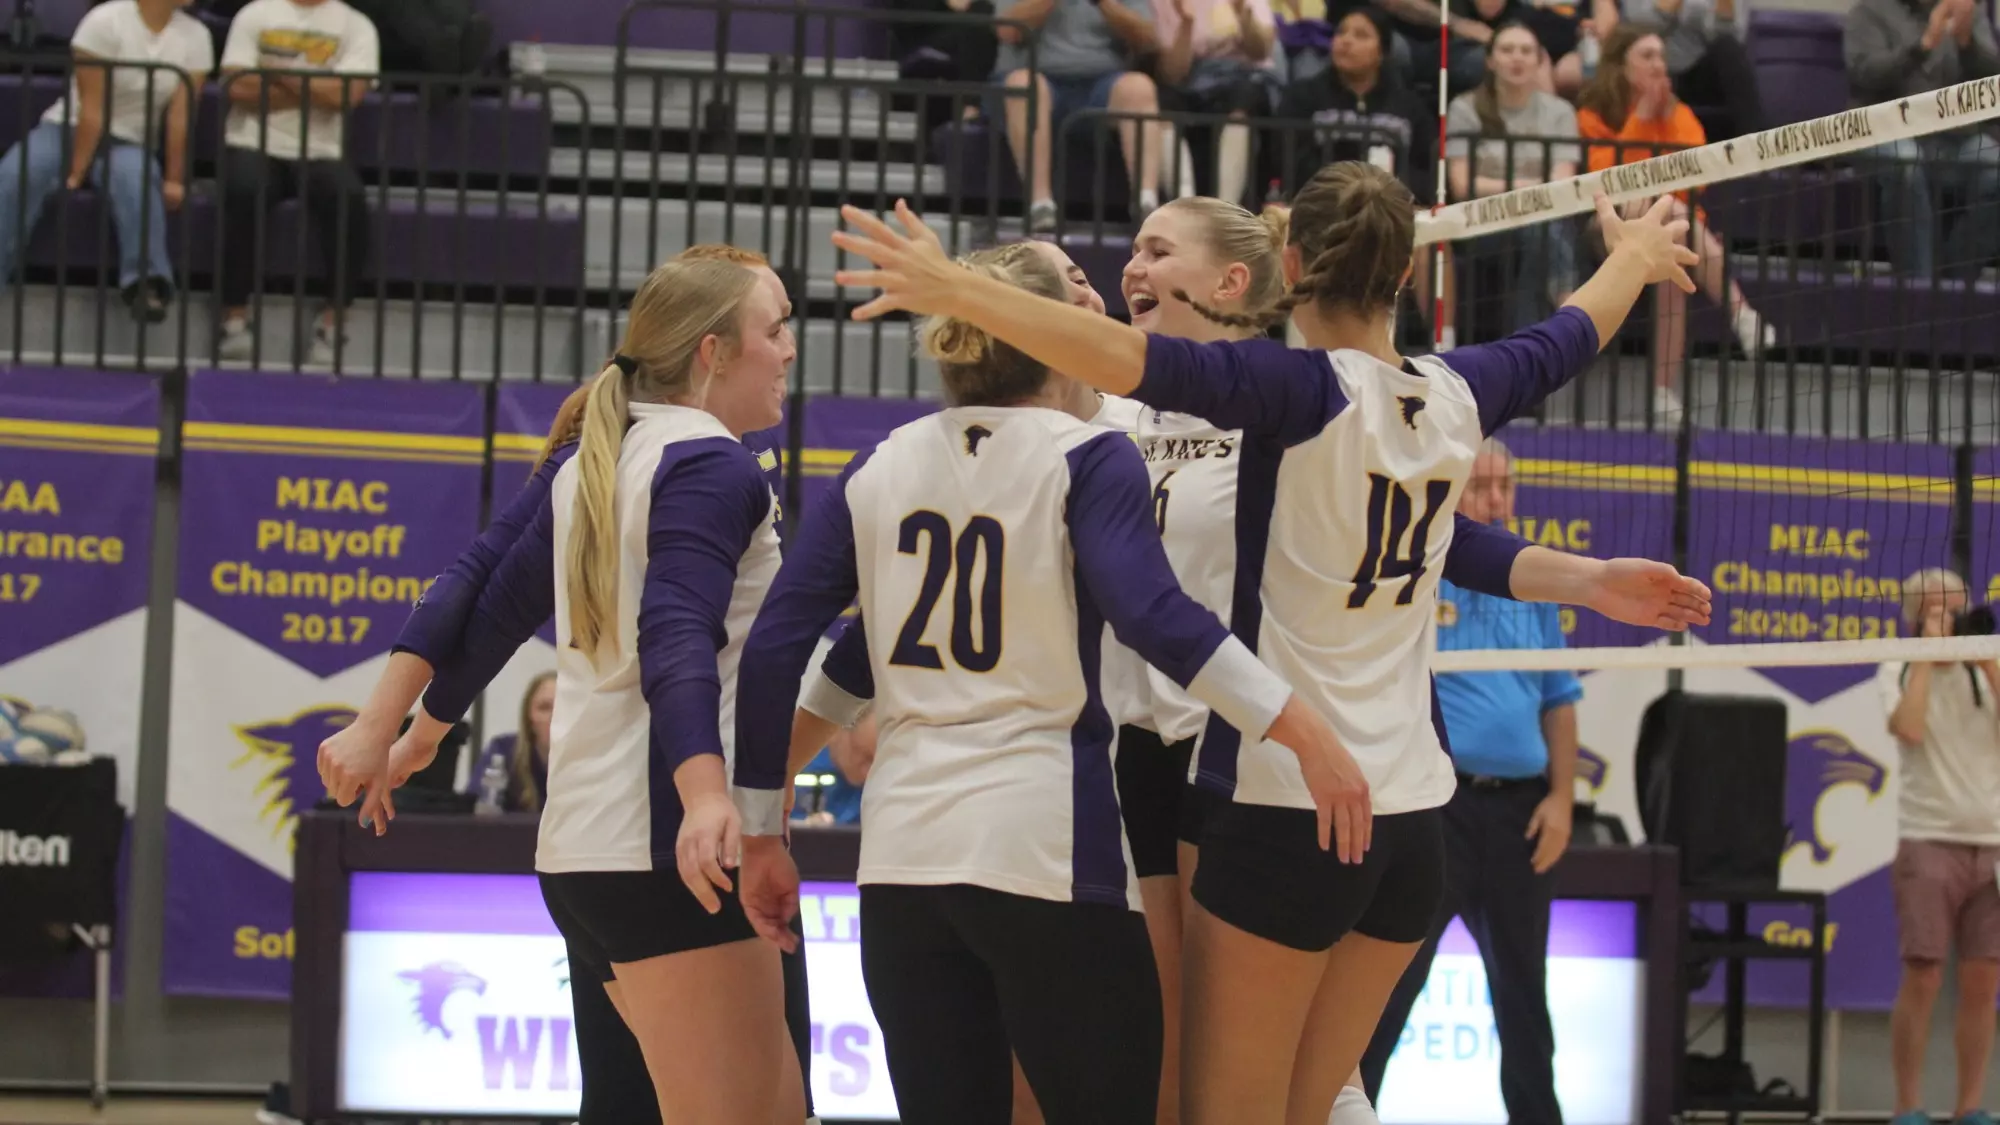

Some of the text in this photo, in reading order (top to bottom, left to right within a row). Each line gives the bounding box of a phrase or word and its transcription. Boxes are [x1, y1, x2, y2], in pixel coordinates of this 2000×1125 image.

[1936, 79, 1996, 119] ST. KATE'S
[1756, 109, 1873, 160] ST. KATE'S VOLLEYBALL
[0, 479, 60, 516] AA
[276, 476, 389, 513] MIAC
[0, 530, 124, 564] rance
[256, 519, 406, 562] Playoff
[1346, 472, 1451, 609] 14
[1508, 517, 1592, 551] IAC
[1769, 523, 1871, 560] MIAC
[211, 560, 436, 606] Champion
[888, 509, 1005, 673] 20
[1712, 560, 1901, 605] Champion
[280, 612, 371, 645] 2017
[1729, 608, 1898, 640] 2020-2021
[1763, 920, 1839, 953] Gof
